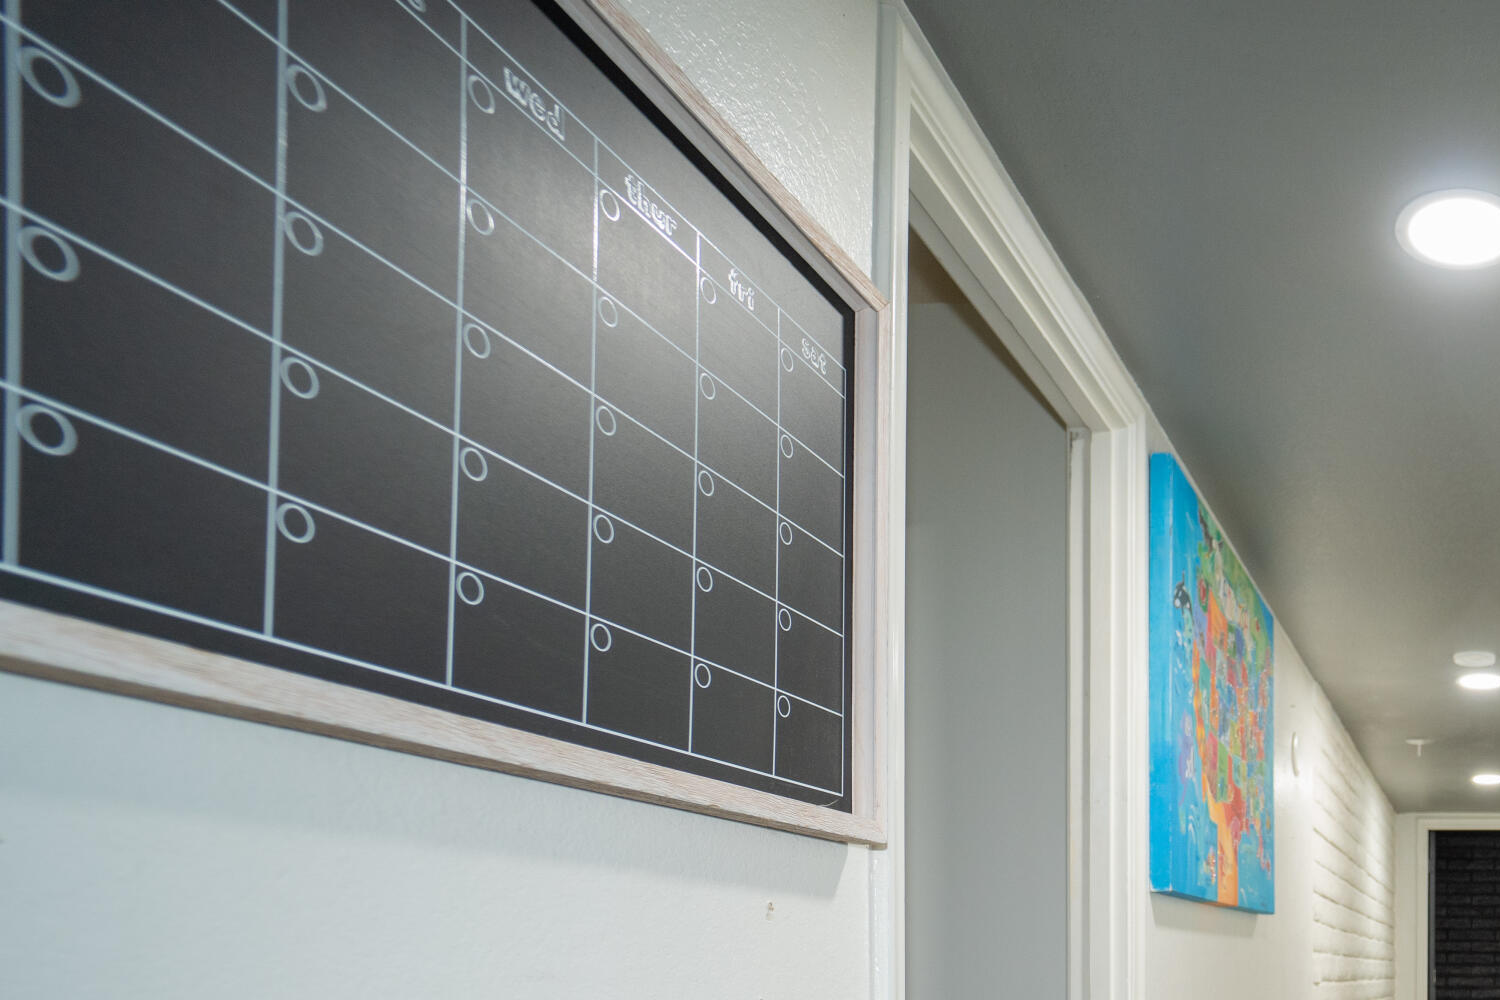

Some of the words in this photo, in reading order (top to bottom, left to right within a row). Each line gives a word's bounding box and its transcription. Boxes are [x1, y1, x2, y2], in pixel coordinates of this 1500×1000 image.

[503, 66, 565, 141] wed
[624, 174, 678, 237] thur
[728, 268, 755, 311] fri
[801, 337, 828, 374] sat
